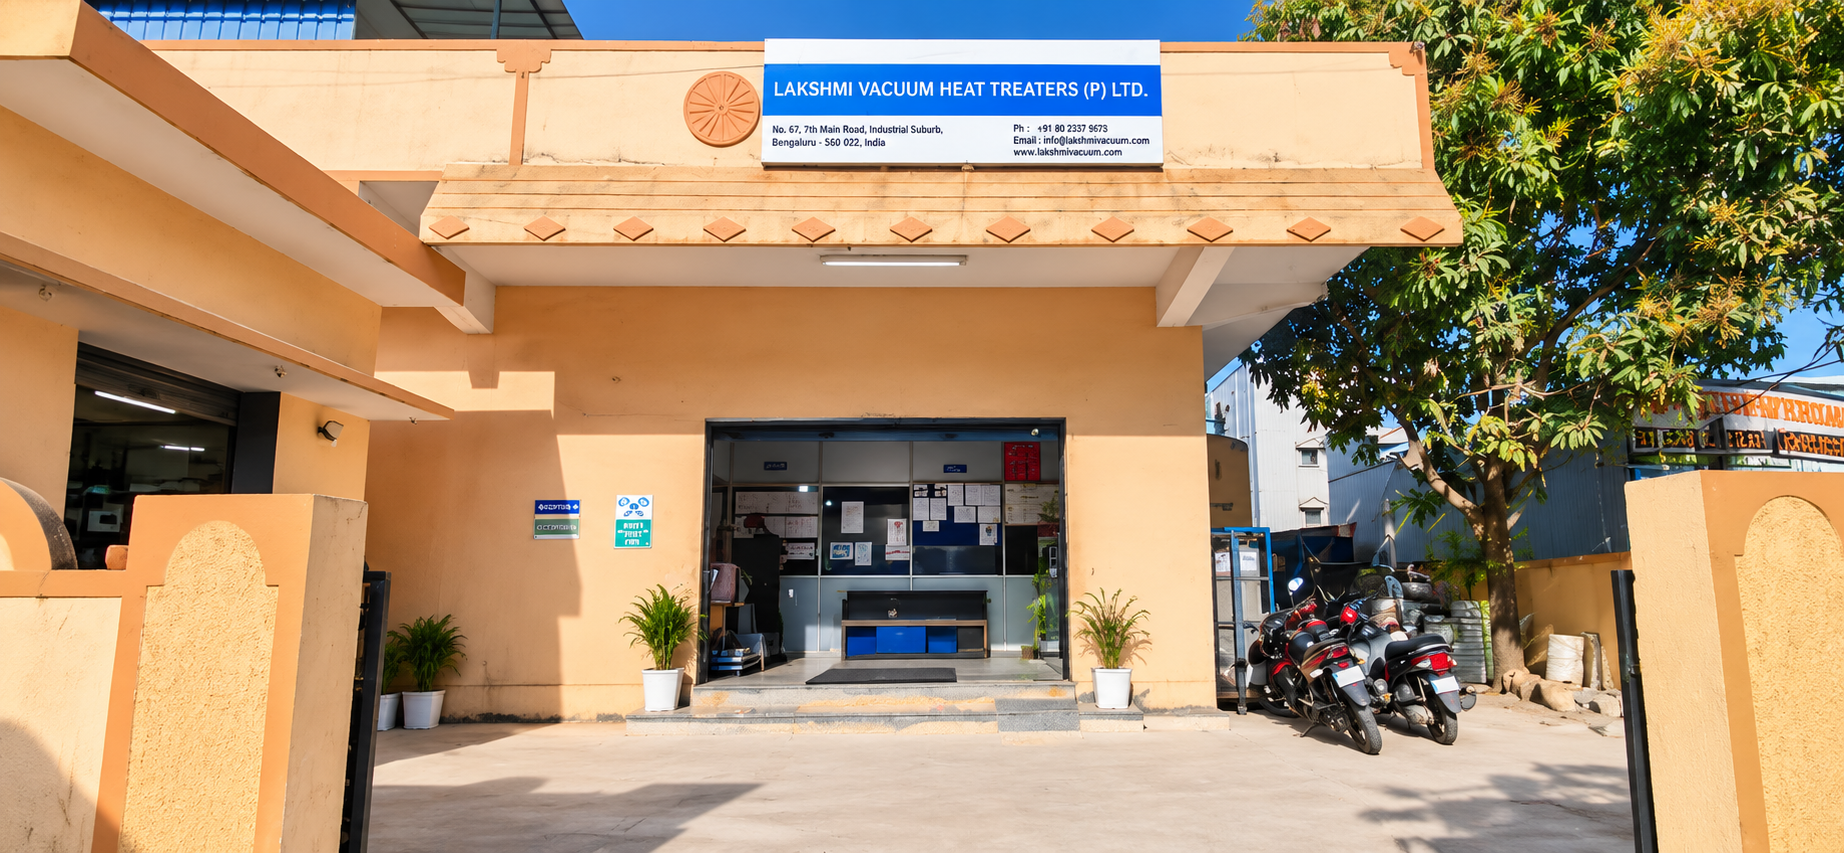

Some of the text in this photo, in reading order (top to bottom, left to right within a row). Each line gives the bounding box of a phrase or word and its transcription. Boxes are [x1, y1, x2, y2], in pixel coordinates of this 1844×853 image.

[774, 81, 1149, 100] LAKSHMI VACUUM HEAT TREATERS (P) LTD.
[772, 124, 944, 135] No. 67, 7th Main Road, Industrial Suburb,
[1013, 123, 1025, 133] Ph
[1054, 124, 1066, 133] 80
[1066, 124, 1087, 133] 2337
[771, 137, 817, 148] Bengaluru
[843, 138, 863, 148] 022,
[864, 137, 886, 147] India
[1013, 135, 1037, 145] Email
[1043, 135, 1150, 147] info@lakshmivacuum.com
[1013, 147, 1123, 157] www.lakshmivacuum.com
